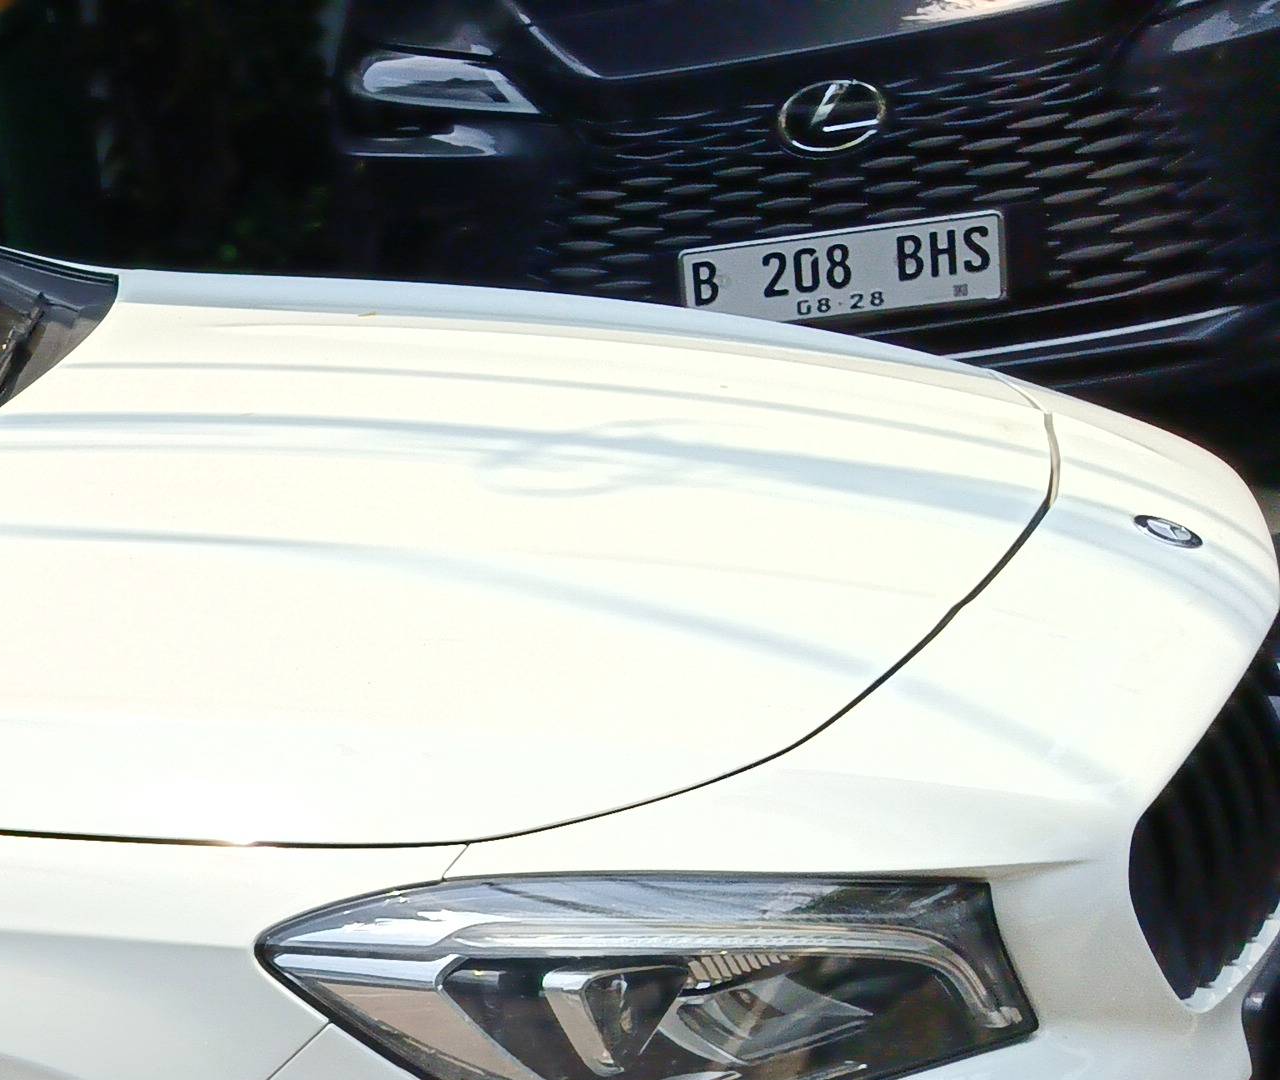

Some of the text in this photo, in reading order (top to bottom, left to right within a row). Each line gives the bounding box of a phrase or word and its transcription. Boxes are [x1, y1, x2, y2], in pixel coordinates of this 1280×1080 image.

[692, 226, 990, 306] B 208 BHS
